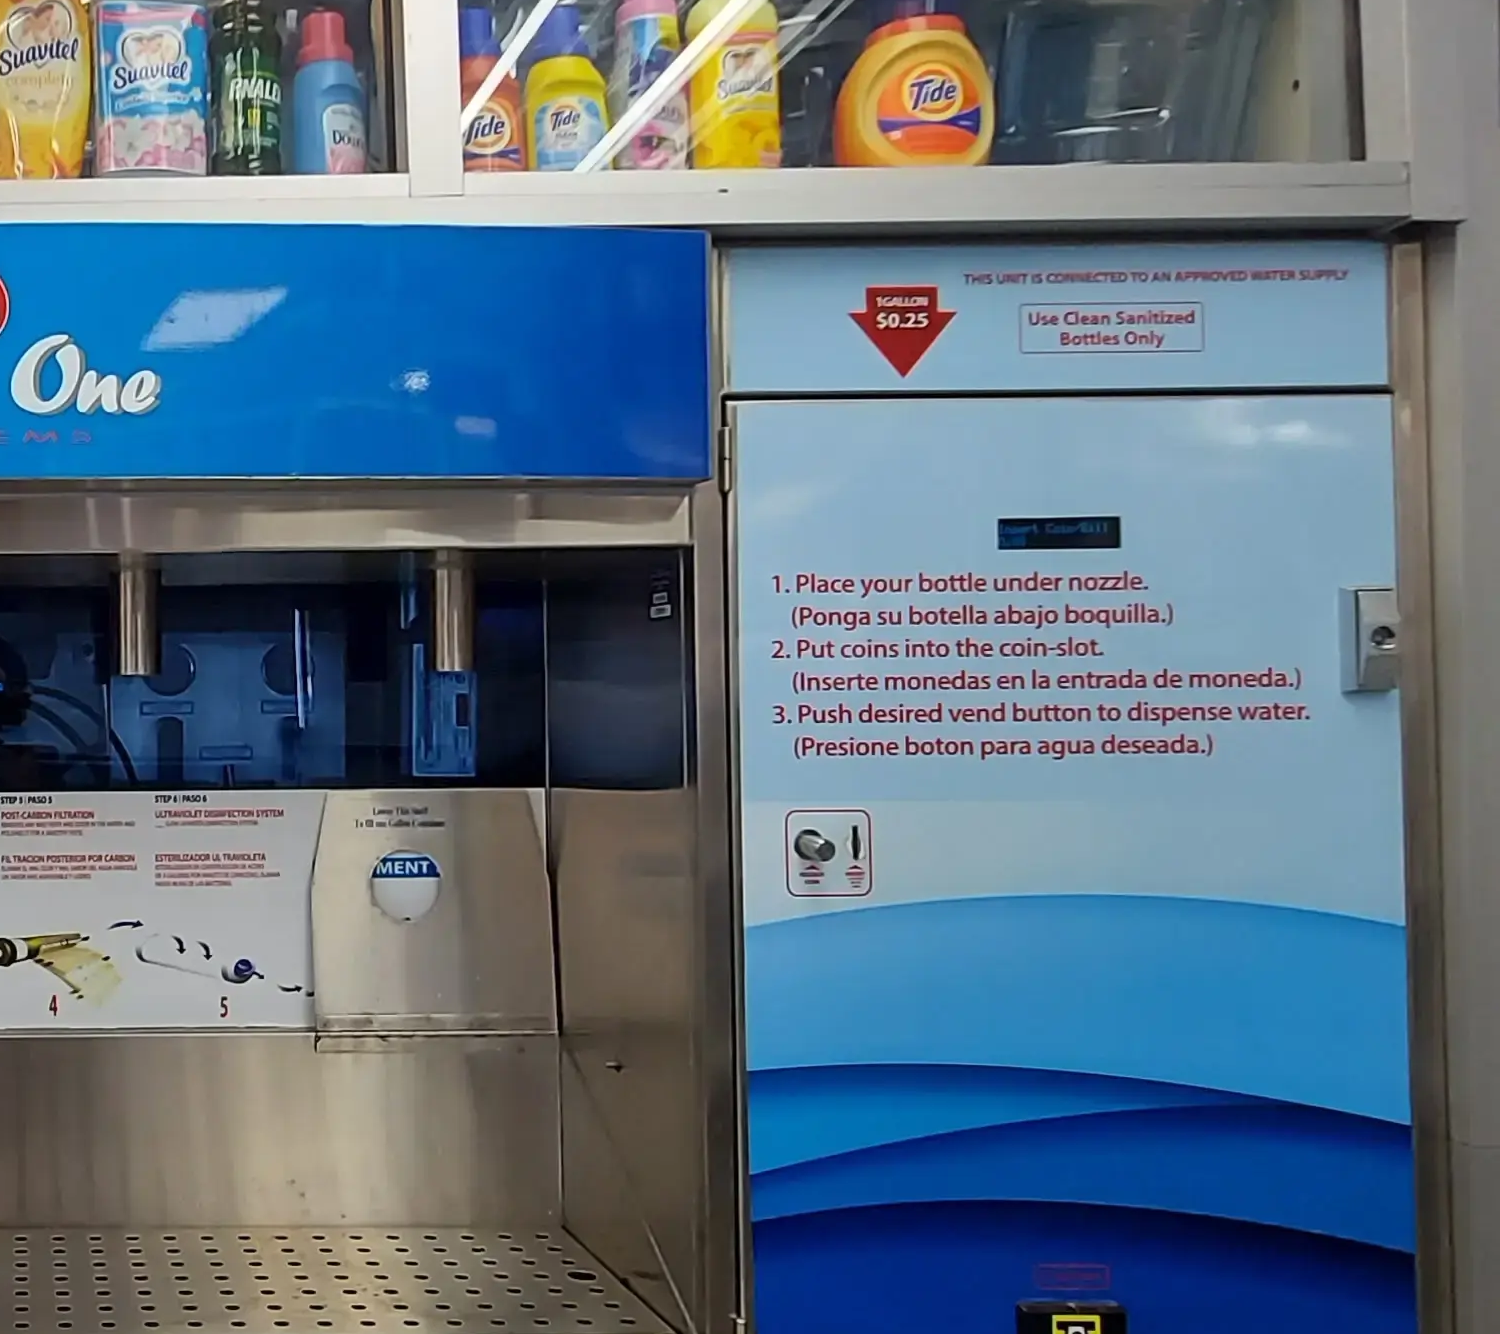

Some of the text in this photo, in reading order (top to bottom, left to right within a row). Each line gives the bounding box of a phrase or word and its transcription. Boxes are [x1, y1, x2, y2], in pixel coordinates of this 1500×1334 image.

[113, 60, 189, 89] Suavitel
[910, 78, 957, 110] Tide
[550, 110, 581, 131] Tide
[964, 269, 1348, 285] THIS UNIT IS CONNECTED TO AN APPROVED WATER SUPPLY
[876, 312, 930, 329] $0.25
[1028, 309, 1195, 326] Use Clean Sanitized
[1060, 331, 1166, 348] Bottles Only
[10, 334, 162, 417] One
[772, 571, 1150, 599] 1. Place your bottle under nozzle.
[791, 602, 1174, 631] (Ponga su botella abajo boquilla.)
[771, 636, 1104, 659] 2. Put coins into the coin-slot.
[791, 667, 1301, 695] (Inserte monedas en la entrada de moneda.)
[772, 701, 1311, 727] 3. Push desired vend button to dispense water.
[793, 734, 1214, 762] (Presione boton para agua deseada.)
[1, 796, 17, 804] STEP
[28, 796, 47, 804] PASO
[155, 795, 172, 803] STEP
[182, 795, 201, 803] PASO
[376, 860, 431, 876] MENT
[48, 994, 58, 1017] 4
[219, 996, 229, 1018] 5
